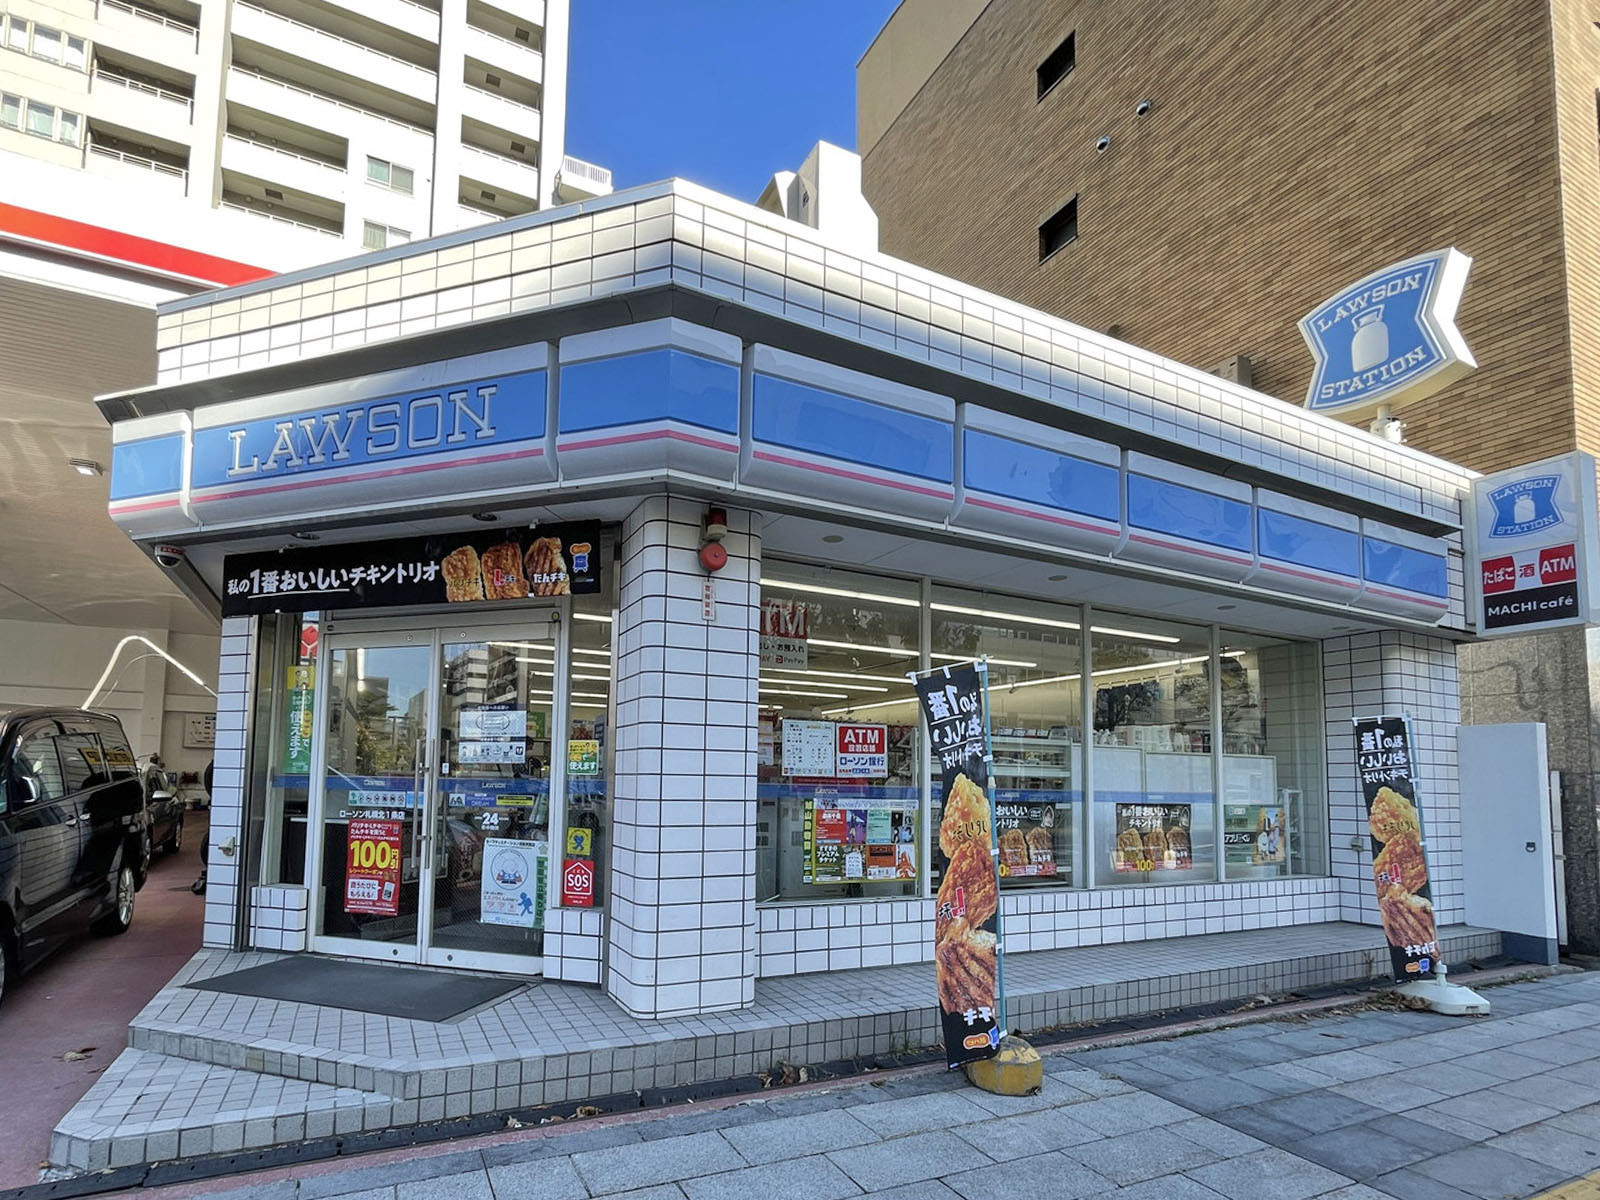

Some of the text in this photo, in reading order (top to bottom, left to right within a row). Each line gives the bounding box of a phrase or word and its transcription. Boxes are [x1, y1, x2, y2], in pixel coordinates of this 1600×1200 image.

[1317, 273, 1423, 332] LAWSON
[1321, 345, 1427, 399] STATION
[228, 385, 497, 477] LAWSON
[1494, 479, 1553, 501] LAWSON
[1496, 515, 1555, 535] STATION
[1519, 563, 1535, 578] 酒
[1541, 556, 1574, 575] ATM
[227, 561, 439, 595] 私の1番おいしいチキントリオ
[533, 573, 567, 584] たんチキ
[1483, 566, 1515, 584] たばこ
[1488, 595, 1573, 617] MACHI café
[844, 729, 879, 744] ATM
[569, 762, 596, 770] 使えます
[840, 757, 884, 766] ローソン銀行
[482, 812, 499, 825] 24
[996, 805, 1027, 816] おいしい
[1129, 818, 1161, 828] チキントリオ
[350, 840, 399, 869] 100 円引
[568, 874, 589, 888] SOS
